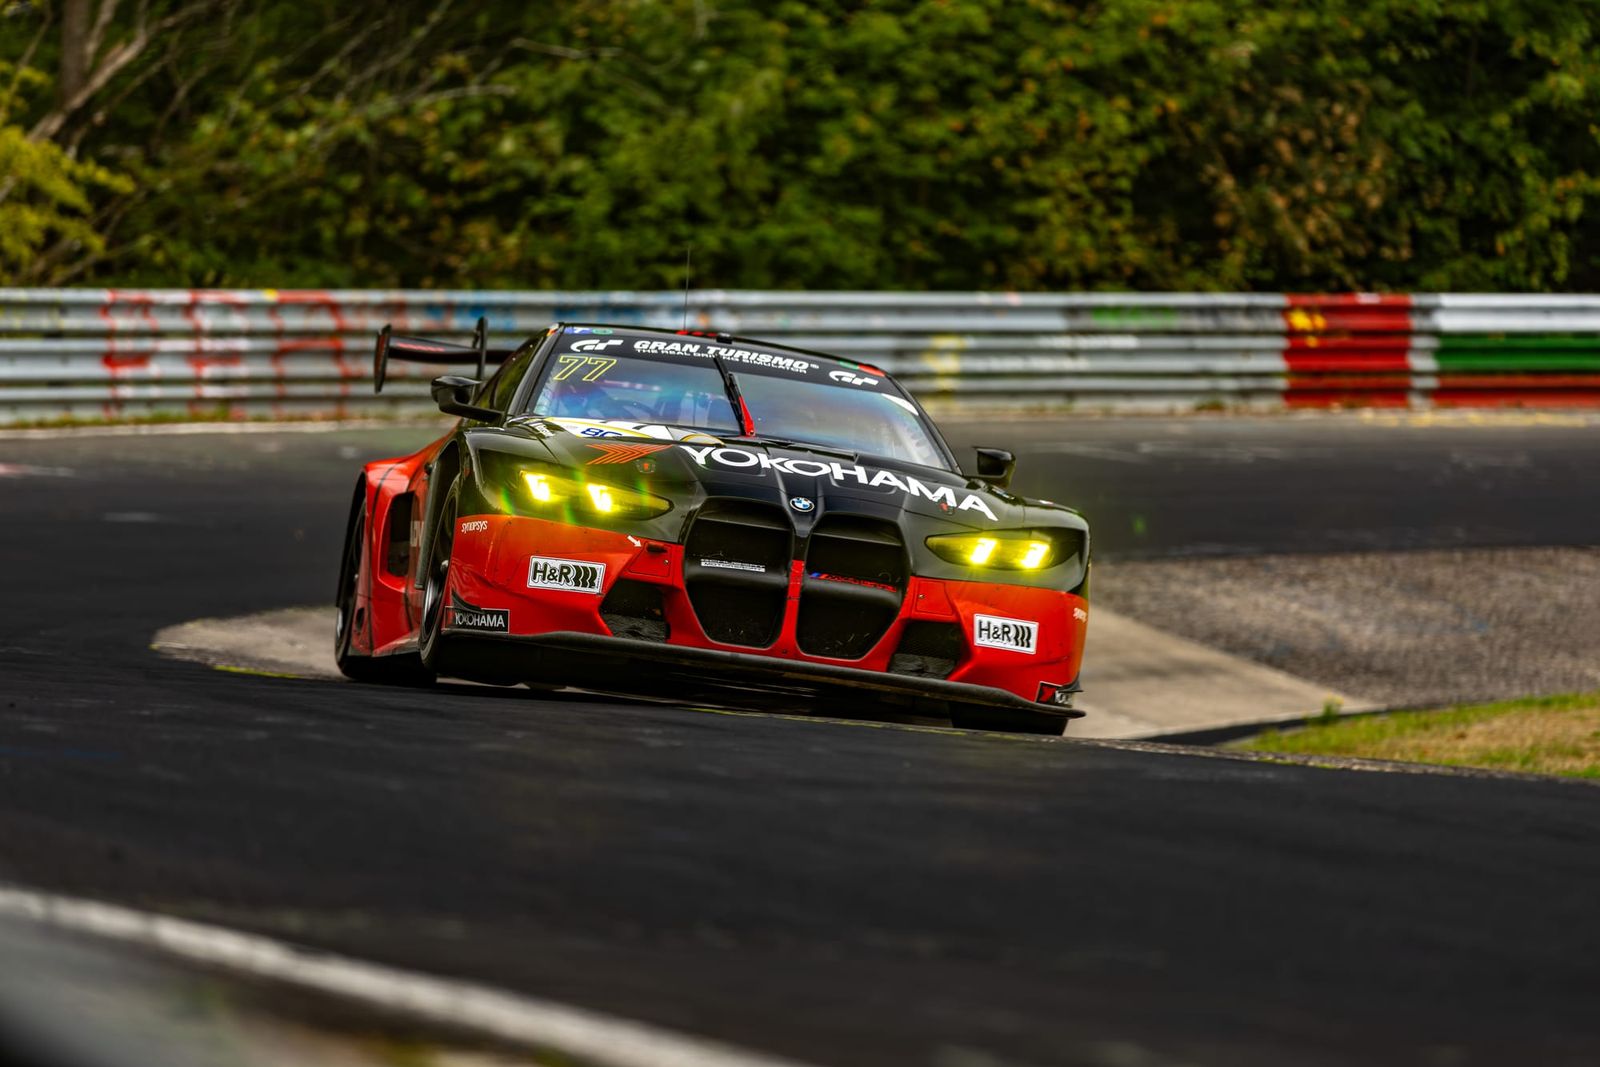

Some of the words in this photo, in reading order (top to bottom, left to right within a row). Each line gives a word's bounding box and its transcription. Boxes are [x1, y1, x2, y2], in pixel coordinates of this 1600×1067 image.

[633, 340, 701, 354] GRAN
[706, 345, 809, 370] TURISMO
[553, 355, 617, 381] 77
[679, 445, 1000, 521] YOKOHAMA
[532, 561, 573, 585] H&R
[455, 612, 506, 628] YOKOHAMA
[978, 619, 1012, 643] H&R
